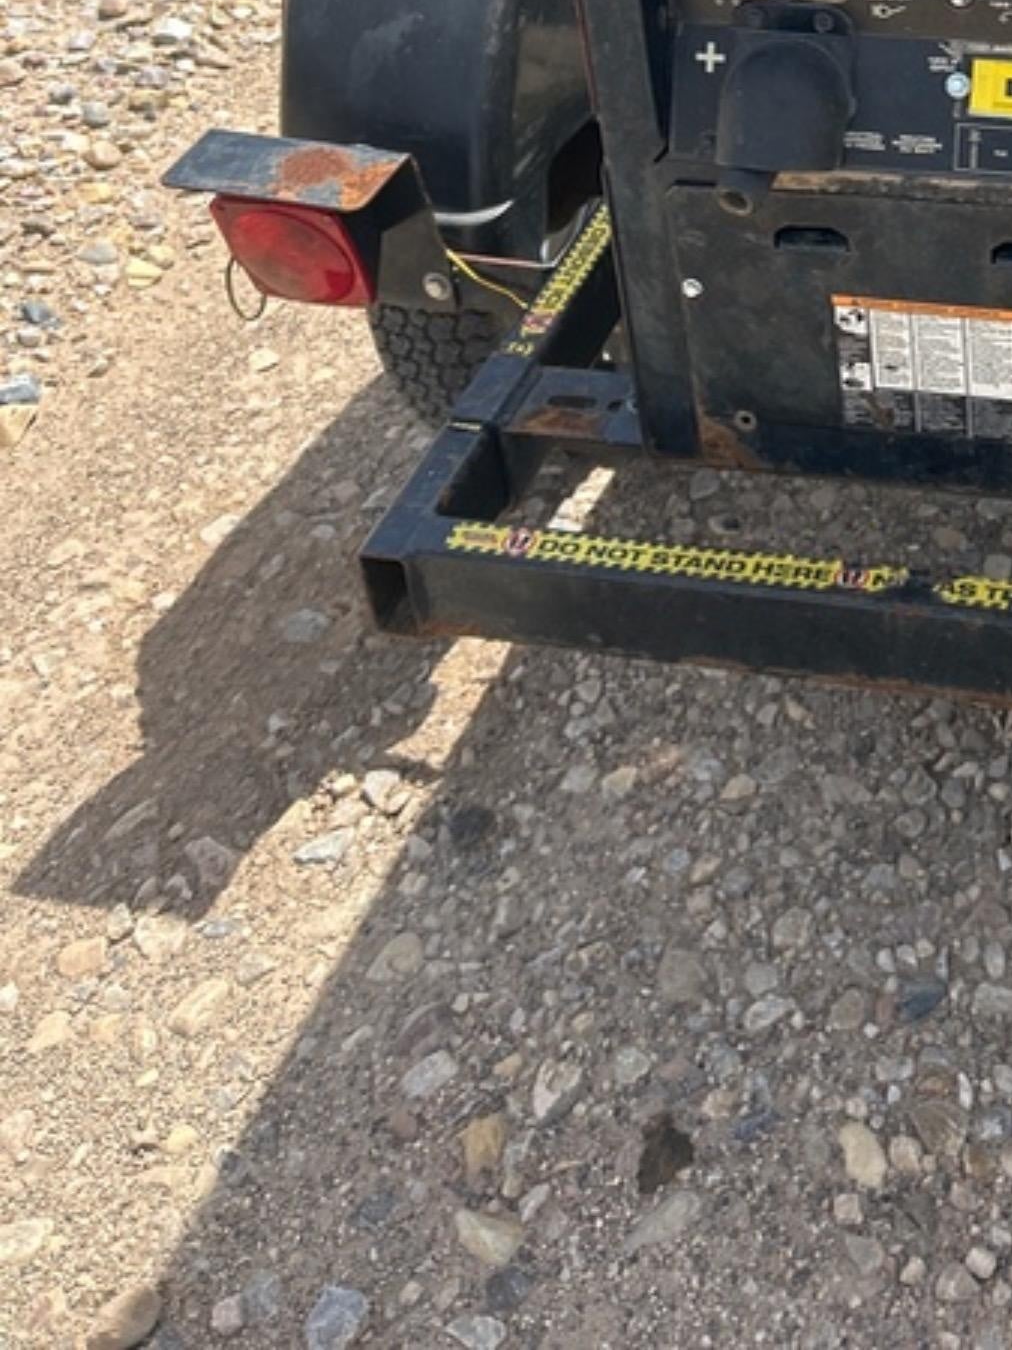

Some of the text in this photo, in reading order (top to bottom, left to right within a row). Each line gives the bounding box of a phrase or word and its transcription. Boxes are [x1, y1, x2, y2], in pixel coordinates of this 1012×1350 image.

[538, 539, 580, 555] DO
[584, 544, 644, 562] NOT
[651, 551, 746, 572] STAND
